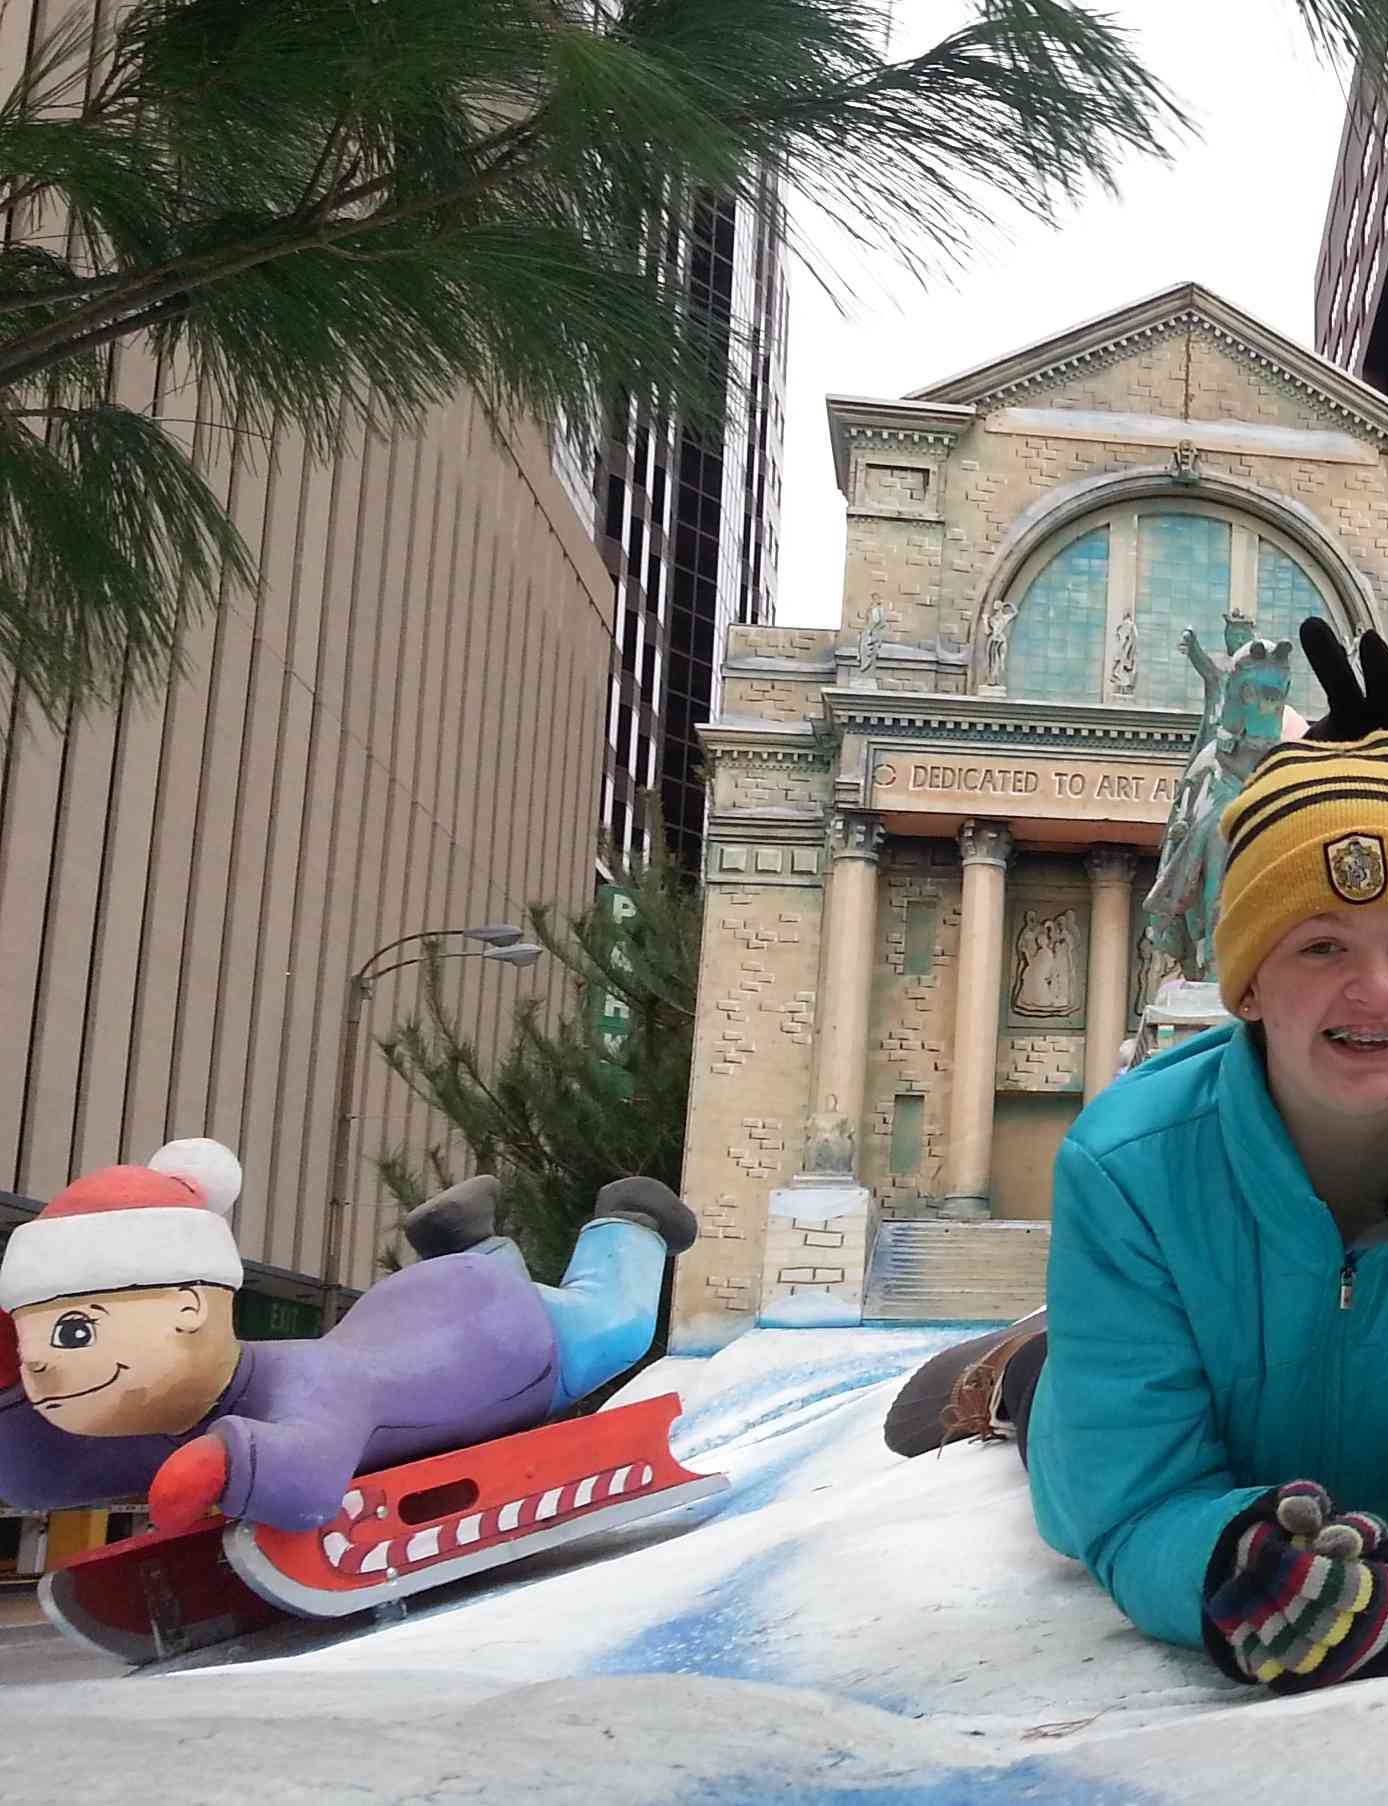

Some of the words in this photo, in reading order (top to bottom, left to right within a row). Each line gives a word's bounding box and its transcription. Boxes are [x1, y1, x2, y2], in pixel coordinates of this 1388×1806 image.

[909, 764, 1039, 795] DEDICATED
[1052, 770, 1086, 799] TO
[1094, 773, 1145, 802] ART
